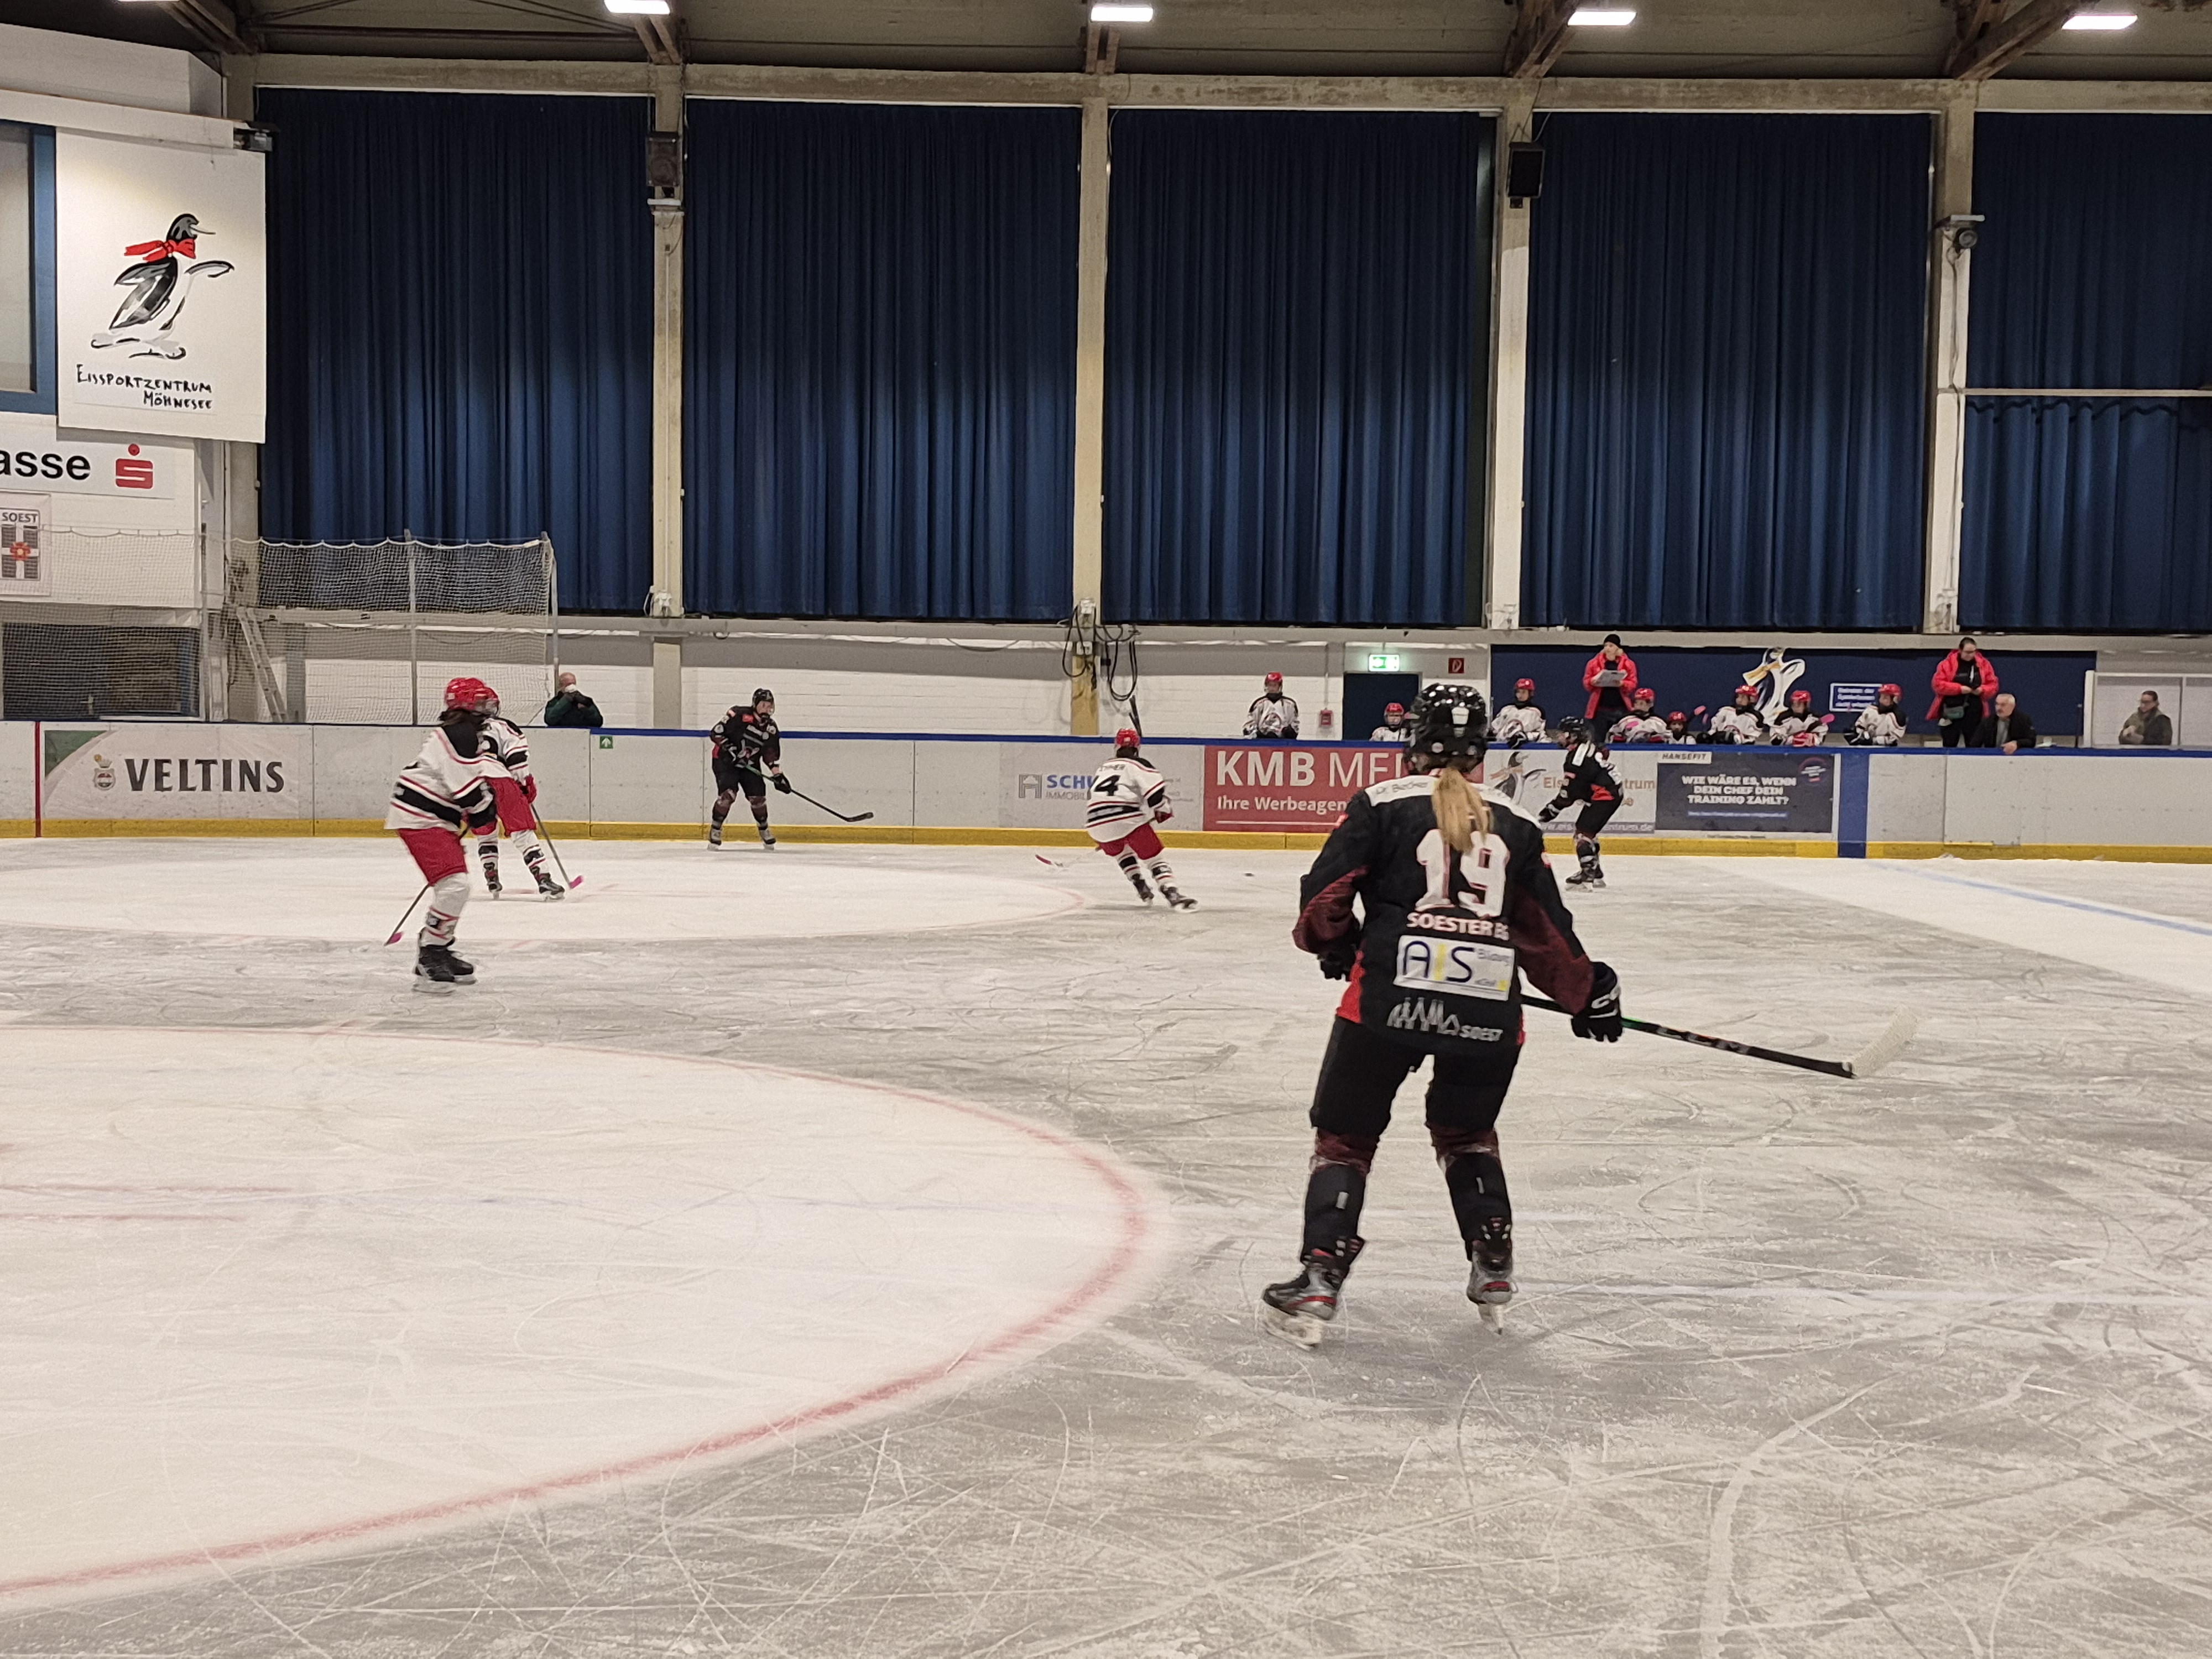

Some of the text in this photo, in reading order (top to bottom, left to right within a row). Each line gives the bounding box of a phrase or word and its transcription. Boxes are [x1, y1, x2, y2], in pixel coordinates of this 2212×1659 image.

[2, 512, 38, 523] SOEST
[124, 758, 285, 793] VELTINS
[1217, 750, 1316, 786] KMB
[1093, 775, 1121, 796] 4
[1682, 776, 1706, 784] WIE
[1761, 777, 1797, 786] WENN
[1694, 785, 1784, 795] DEIN CHEF DEIN
[1217, 795, 1249, 810] Ihre
[1688, 795, 1745, 804] TRAINING
[1415, 828, 1511, 919] 19
[1406, 912, 1493, 936] SOESTER
